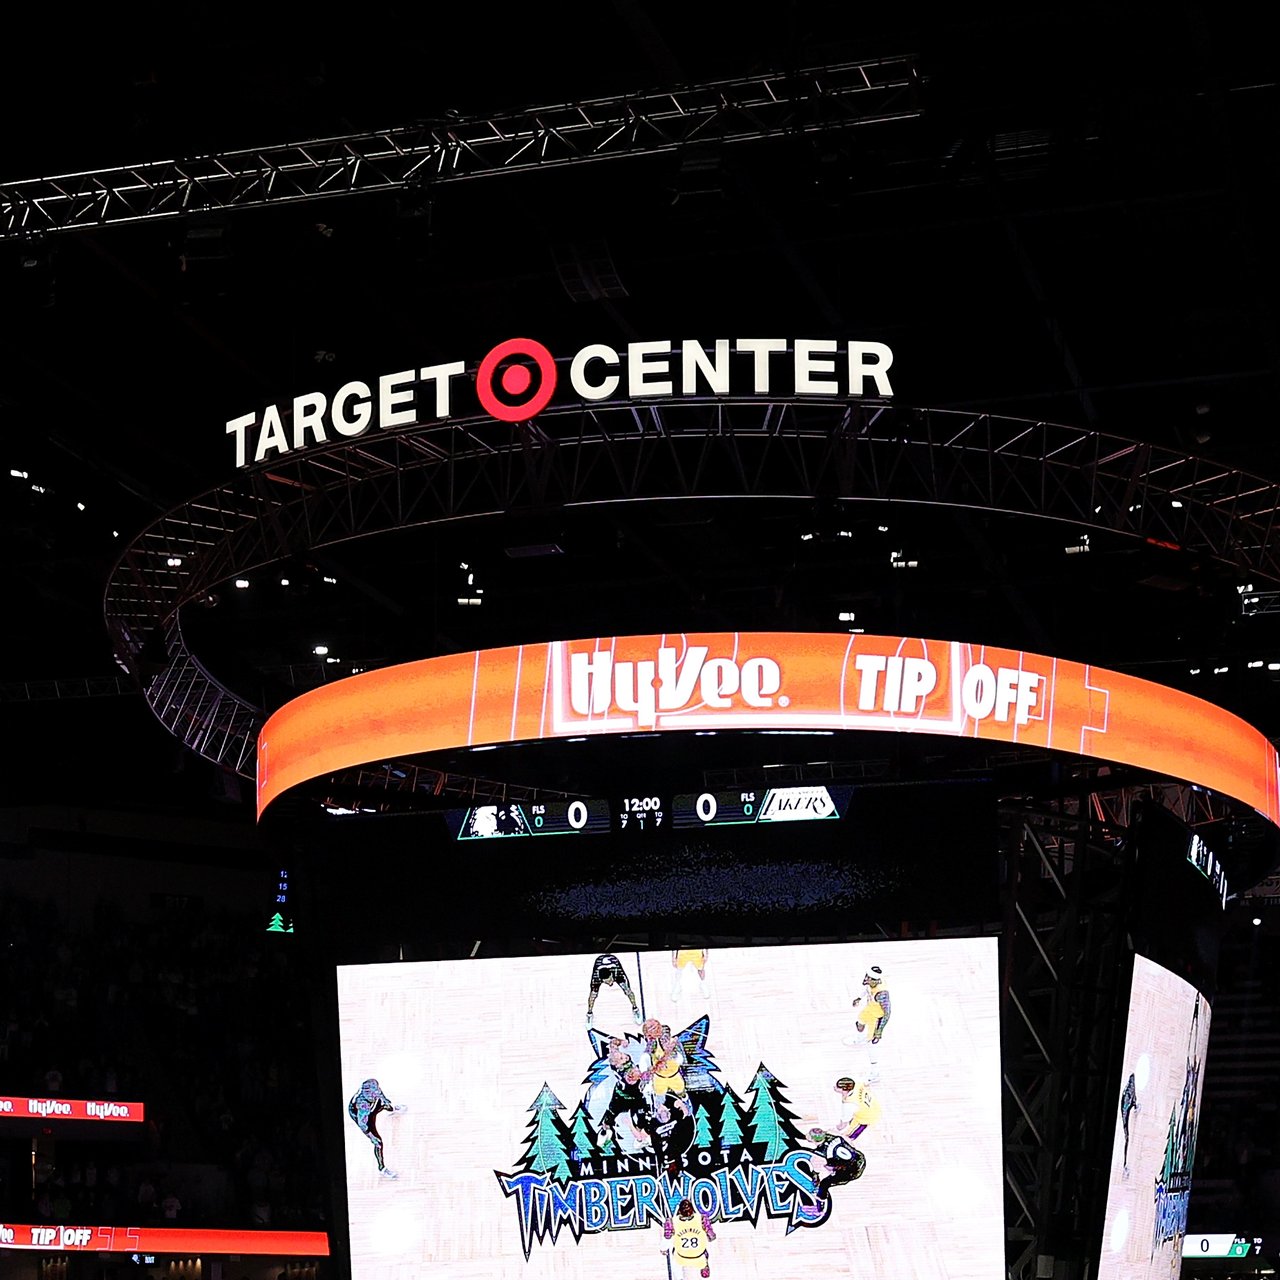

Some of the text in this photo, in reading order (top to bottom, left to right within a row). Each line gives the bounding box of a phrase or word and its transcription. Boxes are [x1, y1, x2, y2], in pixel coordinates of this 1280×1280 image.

[226, 339, 894, 467] TARGET CENTER
[570, 647, 1039, 729] HyVee TIP OFF
[624, 797, 660, 811] 12:00
[741, 793, 755, 802] FLS
[532, 805, 545, 814] FLS
[696, 793, 717, 821] 0
[744, 804, 753, 815] 0
[535, 816, 543, 827] 0
[567, 801, 588, 829] 0
[621, 820, 627, 829] 7
[656, 818, 661, 826] 7
[28, 1099, 72, 1117] HyVee
[87, 1101, 129, 1119] HyVee
[496, 1150, 832, 1260] TIMBERWOLVES
[31, 1228, 56, 1245] TIP
[64, 1229, 91, 1246] OFF
[681, 1238, 699, 1248] 28
[1201, 1239, 1209, 1252] 0
[1236, 1246, 1261, 1254] 0 7
